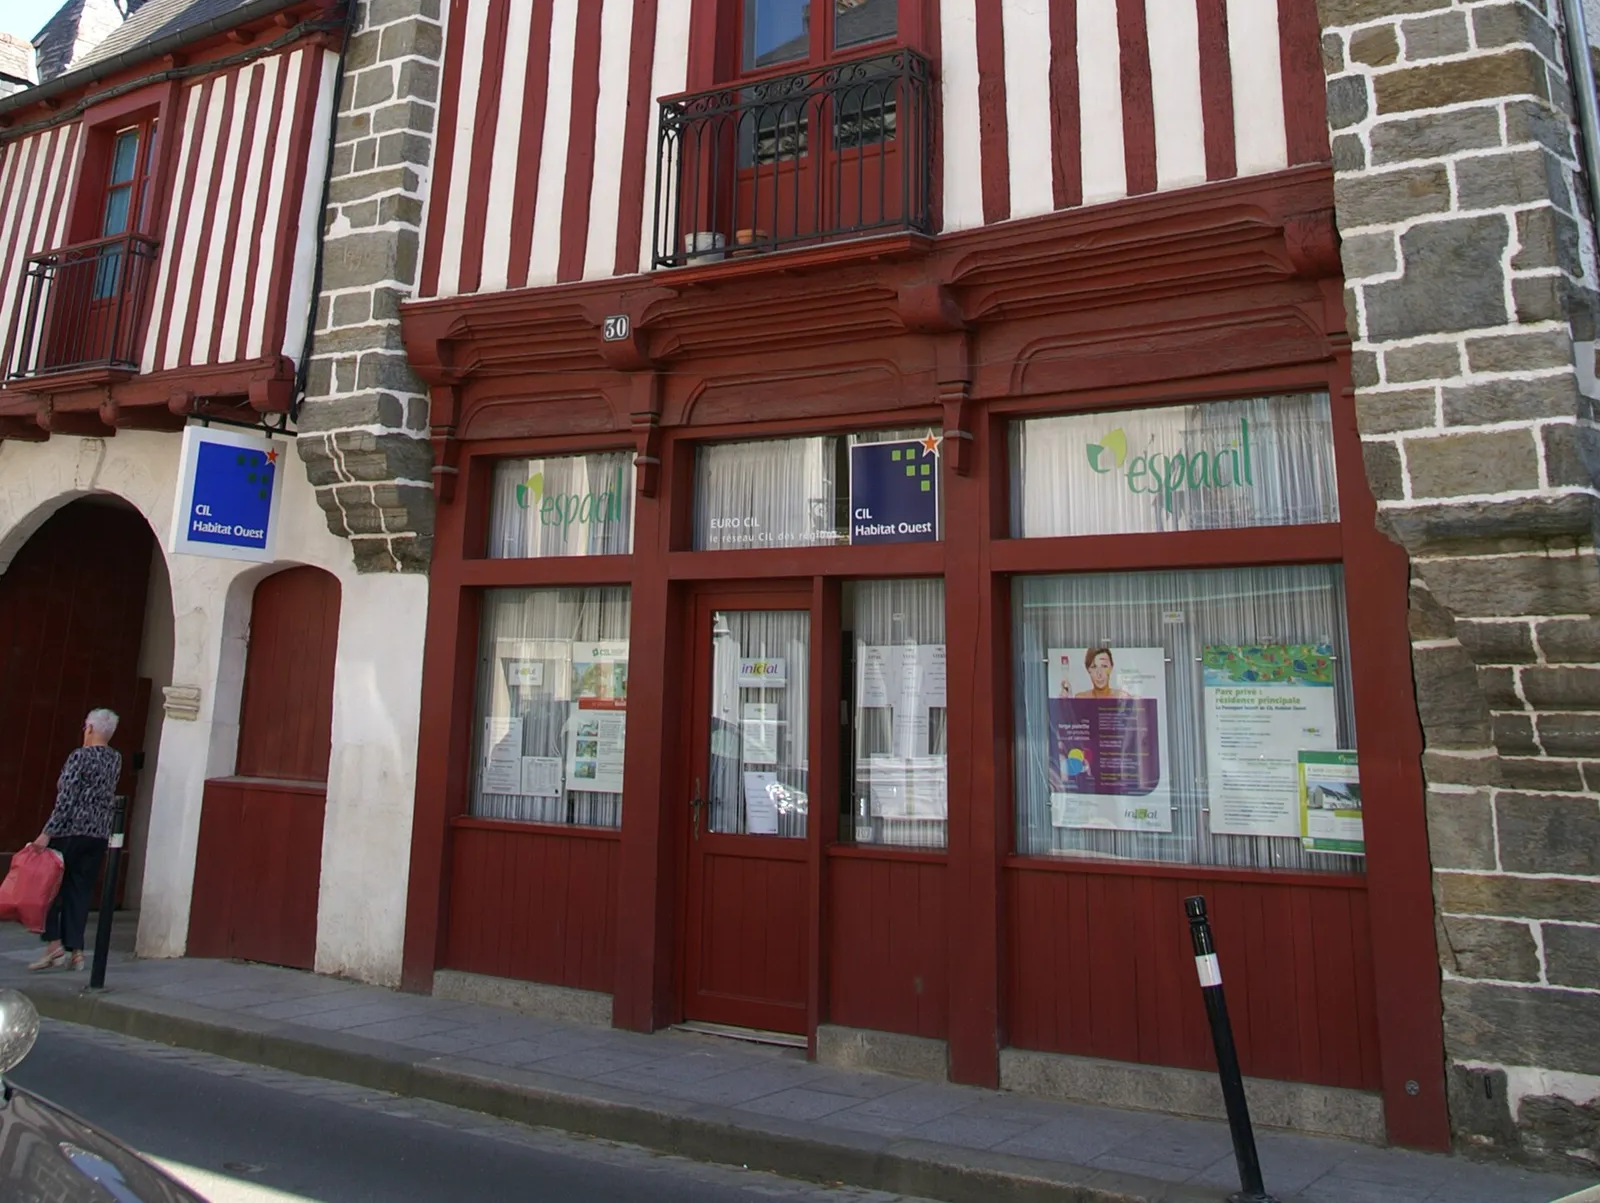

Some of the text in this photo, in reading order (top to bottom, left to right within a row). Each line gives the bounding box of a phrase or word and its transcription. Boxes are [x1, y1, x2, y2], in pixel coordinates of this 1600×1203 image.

[606, 317, 627, 338] 30
[1124, 417, 1253, 514] espacil
[195, 504, 212, 516] CIL
[540, 467, 622, 543] espacil
[855, 508, 873, 520] CIL
[192, 520, 264, 539] Habitat Ouest
[710, 516, 761, 529] EURO CIL
[855, 522, 932, 536] Habitat Ouest
[709, 534, 718, 544] le
[758, 532, 774, 542] CIL
